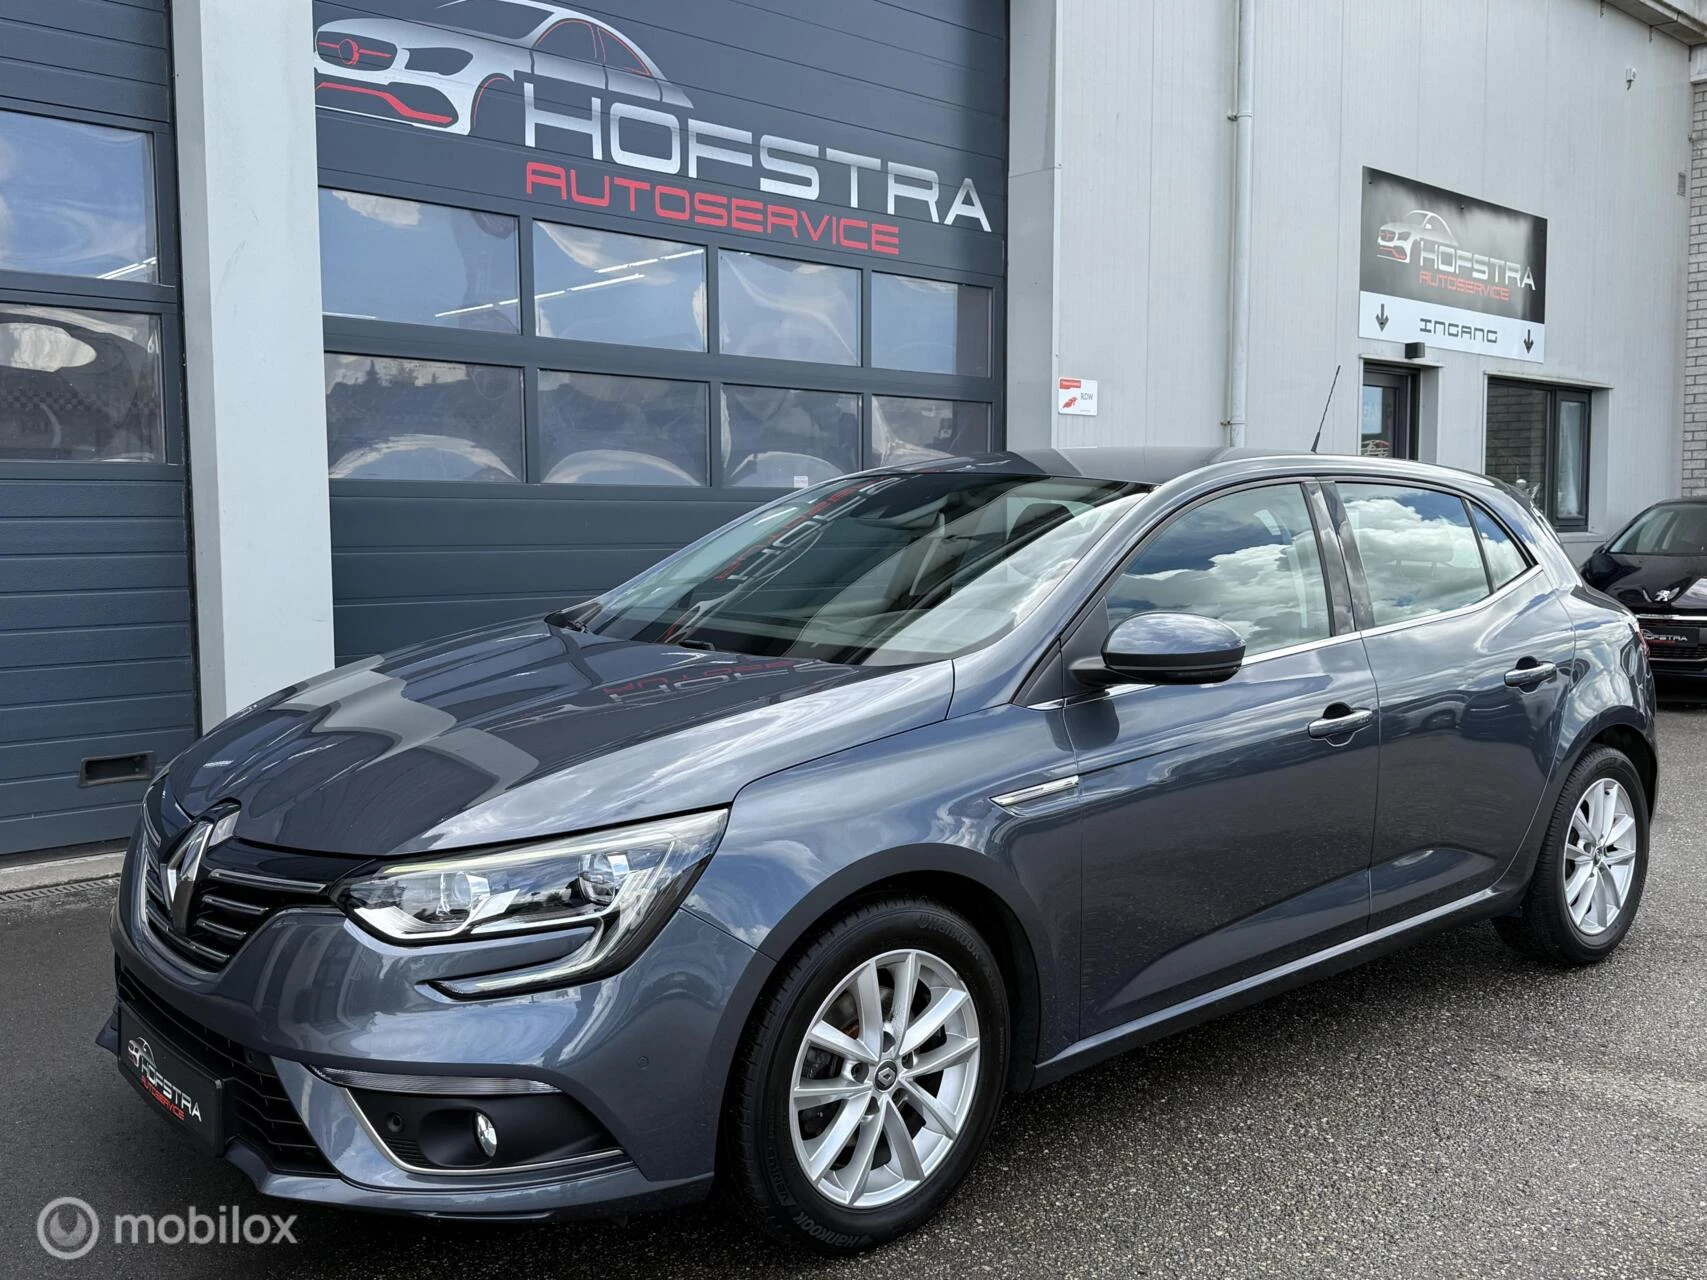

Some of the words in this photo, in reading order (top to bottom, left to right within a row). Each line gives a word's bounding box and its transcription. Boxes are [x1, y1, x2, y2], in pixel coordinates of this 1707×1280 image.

[524, 83, 992, 232] HOFSTRA
[526, 162, 900, 255] AUTOSERVICE
[1419, 271, 1510, 302] AUTOSERVICE
[1420, 240, 1536, 291] HOFSTRA
[1419, 318, 1499, 344] INGANG
[1080, 392, 1093, 400] RDW
[141, 1056, 202, 1122] HOFSTRA
[141, 1074, 185, 1121] AUTOSERVICE
